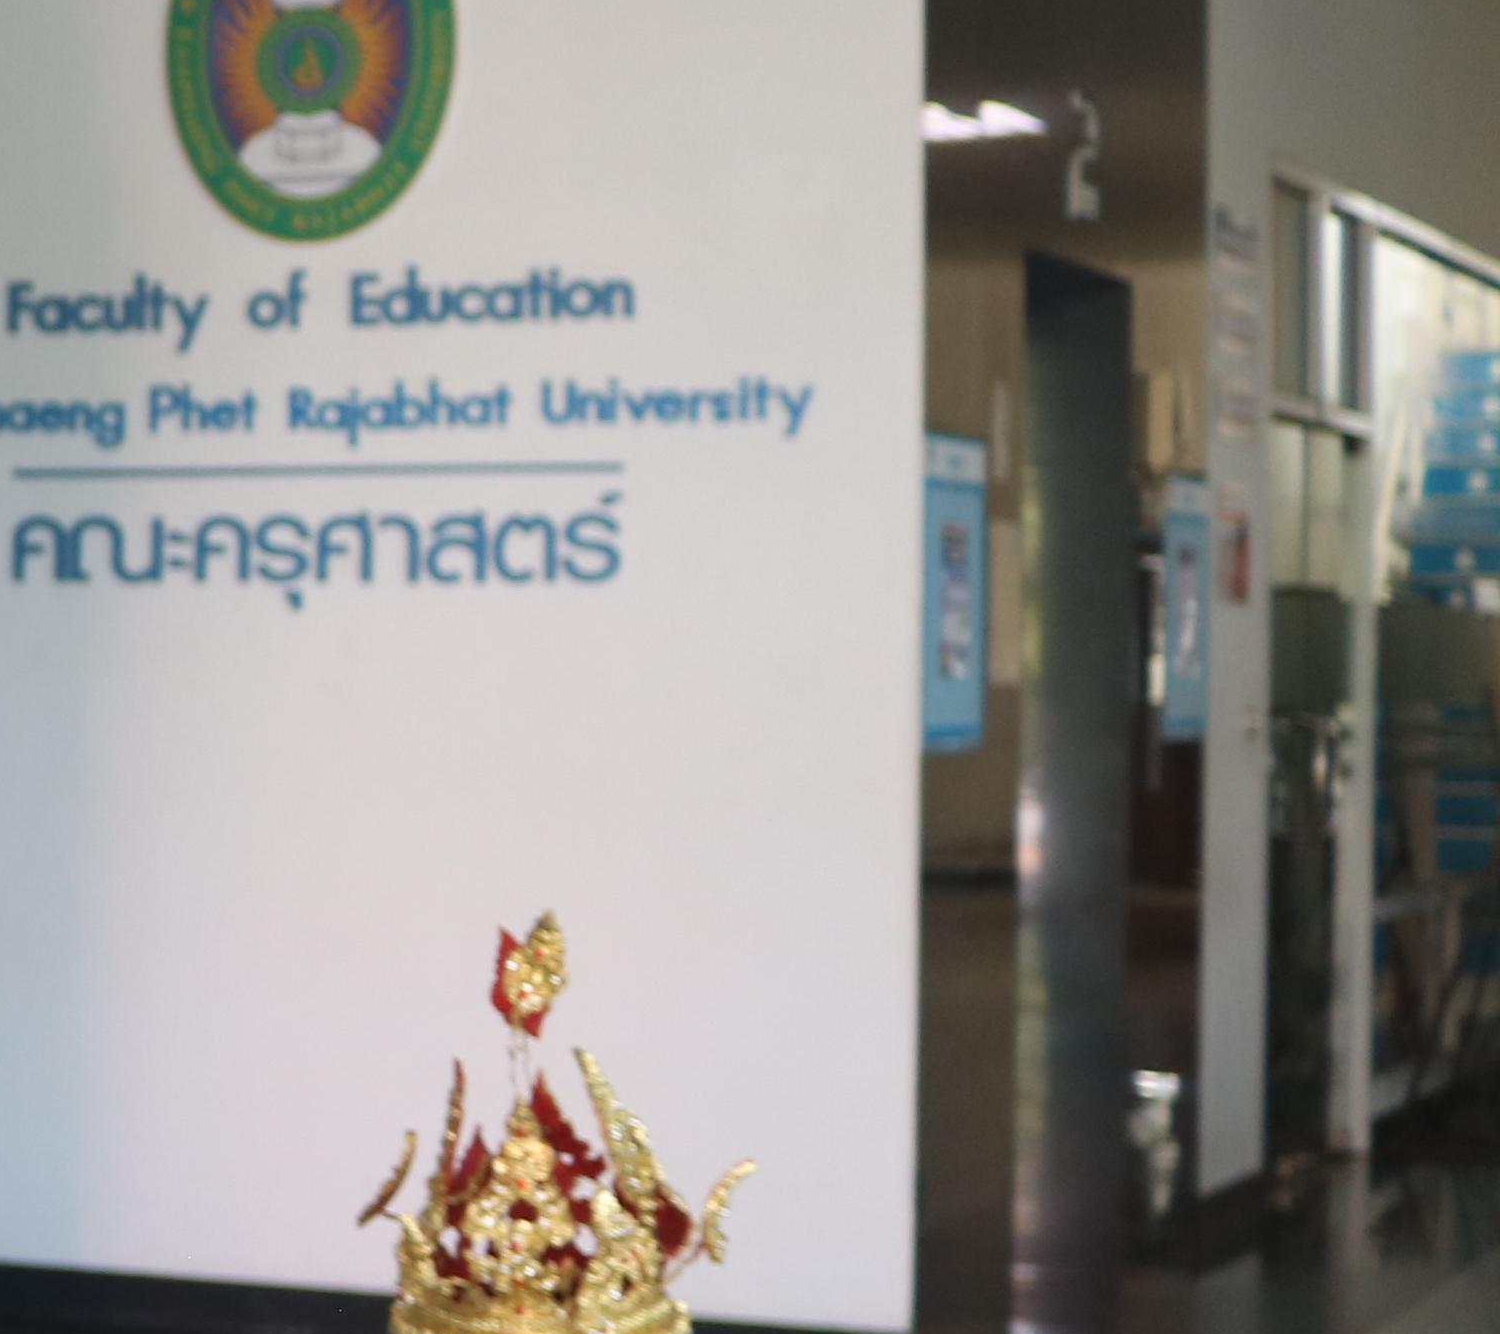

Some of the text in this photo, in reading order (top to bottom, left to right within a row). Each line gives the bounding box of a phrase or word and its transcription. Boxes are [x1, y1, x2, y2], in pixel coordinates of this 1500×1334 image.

[6, 264, 636, 355] Faculty of Education
[148, 383, 257, 433] Phet
[287, 377, 510, 447] Rajabhat
[540, 376, 814, 437] University
[11, 491, 623, 611] คณะครุศาสตร์
